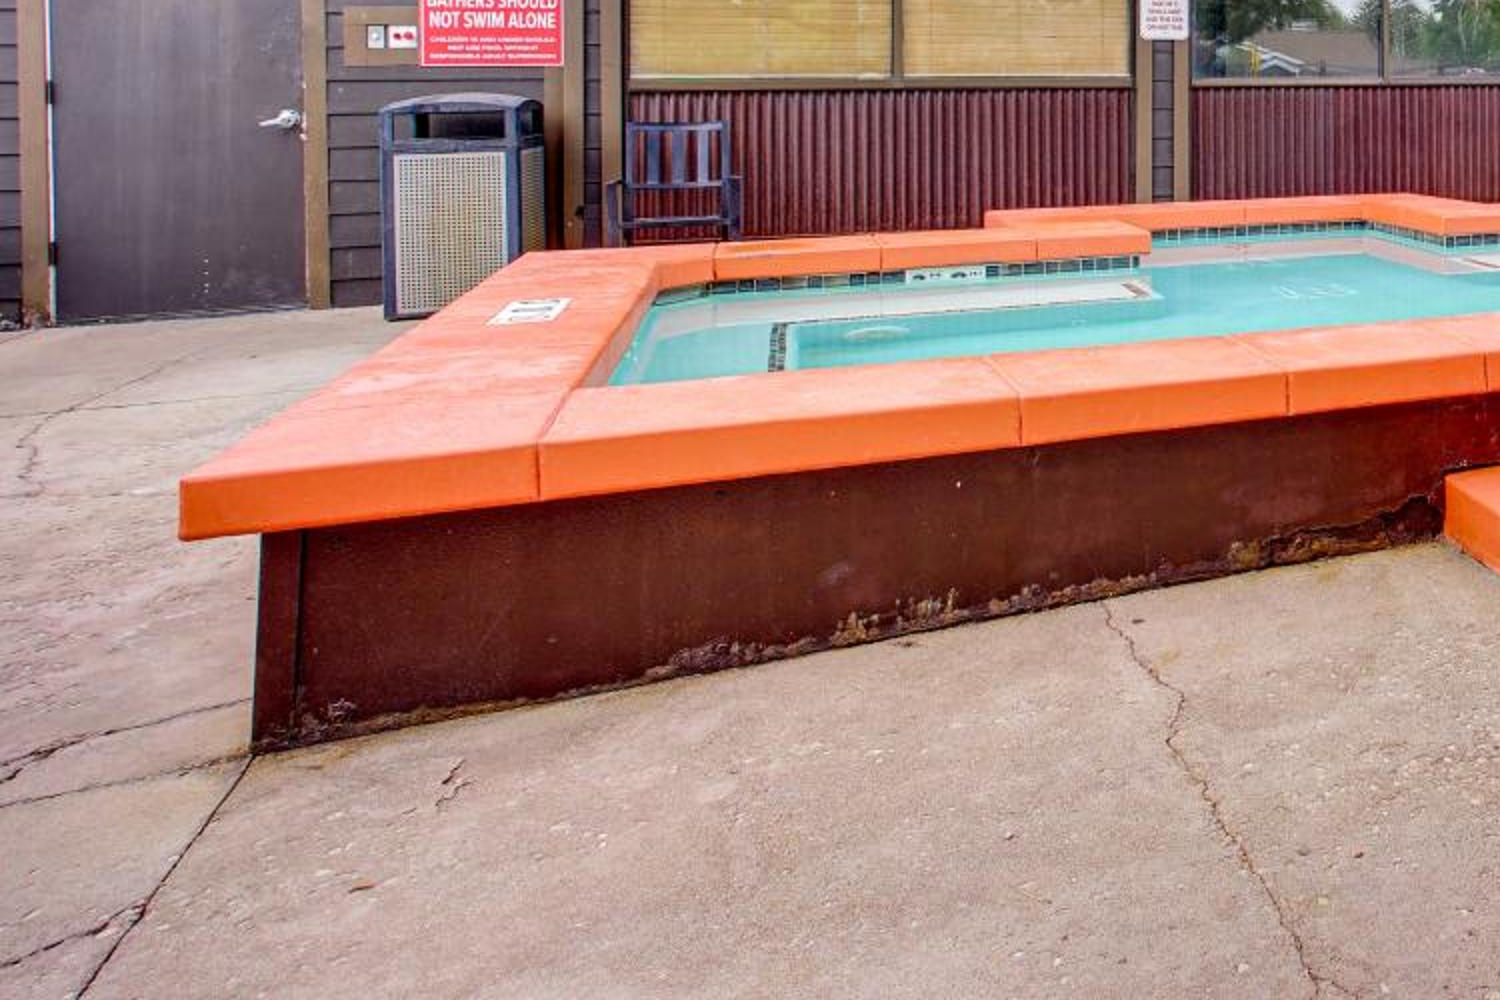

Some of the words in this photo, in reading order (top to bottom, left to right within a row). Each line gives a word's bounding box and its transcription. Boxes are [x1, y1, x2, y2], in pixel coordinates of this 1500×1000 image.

[428, 10, 460, 29] NOT
[463, 11, 505, 29] SWIM
[508, 11, 557, 29] ALONE
